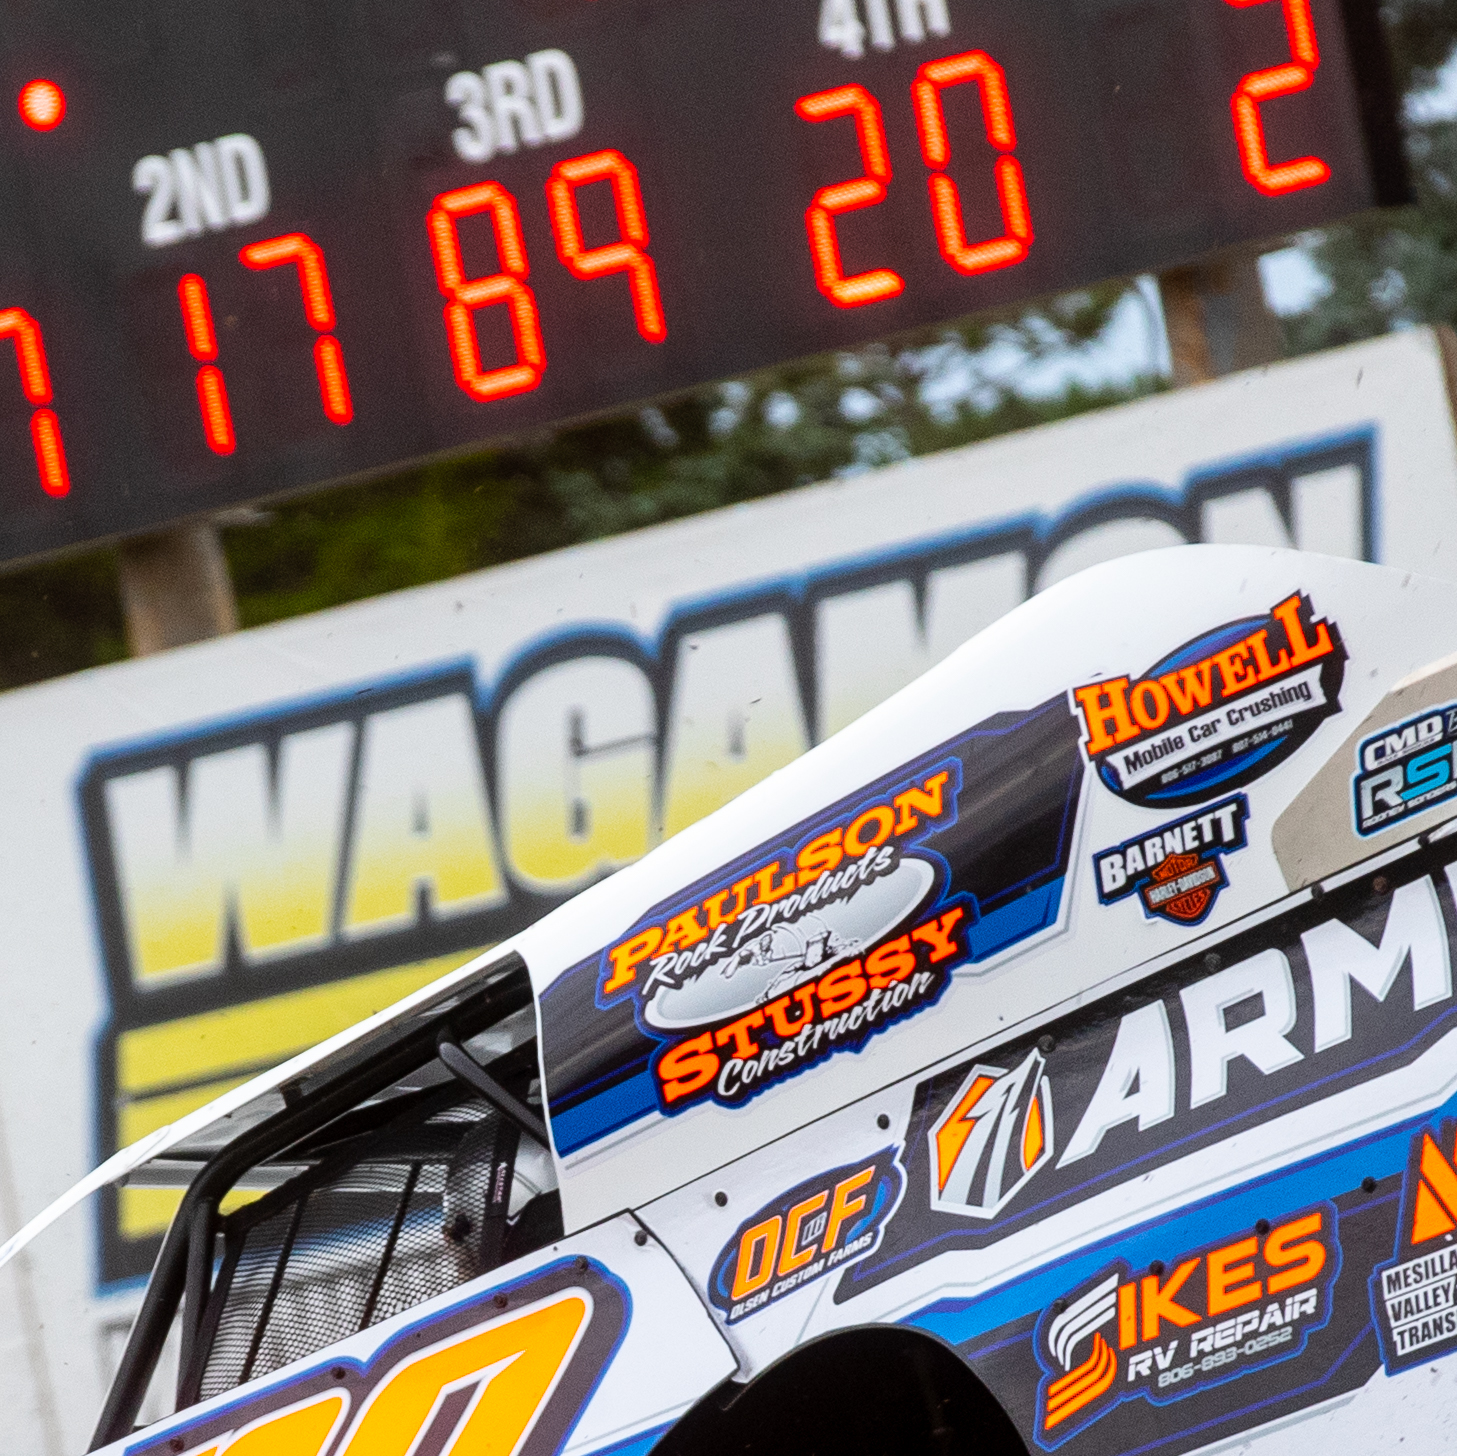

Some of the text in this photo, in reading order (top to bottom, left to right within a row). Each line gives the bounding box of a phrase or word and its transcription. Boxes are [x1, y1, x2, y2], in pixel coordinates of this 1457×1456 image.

[444, 49, 584, 162] 3RD
[1223, 0, 1329, 197] 2
[133, 132, 271, 250] 2ND
[795, 50, 1033, 308] 20
[427, 149, 666, 402] 89
[178, 233, 353, 456] 17
[1075, 594, 1334, 756] HOWELL
[1123, 680, 1312, 775] Mobile Car Crushing
[1364, 715, 1444, 771] CMD
[603, 771, 948, 994] PAULSON
[1100, 803, 1238, 894] BARNETT
[642, 845, 893, 995] Rock Products
[657, 907, 964, 1103] STUSSY
[717, 972, 936, 1097] Construction
[730, 1232, 875, 1320] OLSEN CUSTOM FARMS
[731, 1165, 876, 1301] OCF
[1127, 1288, 1318, 1382] RV REPAIR
[1390, 1281, 1453, 1323] VALLEY
